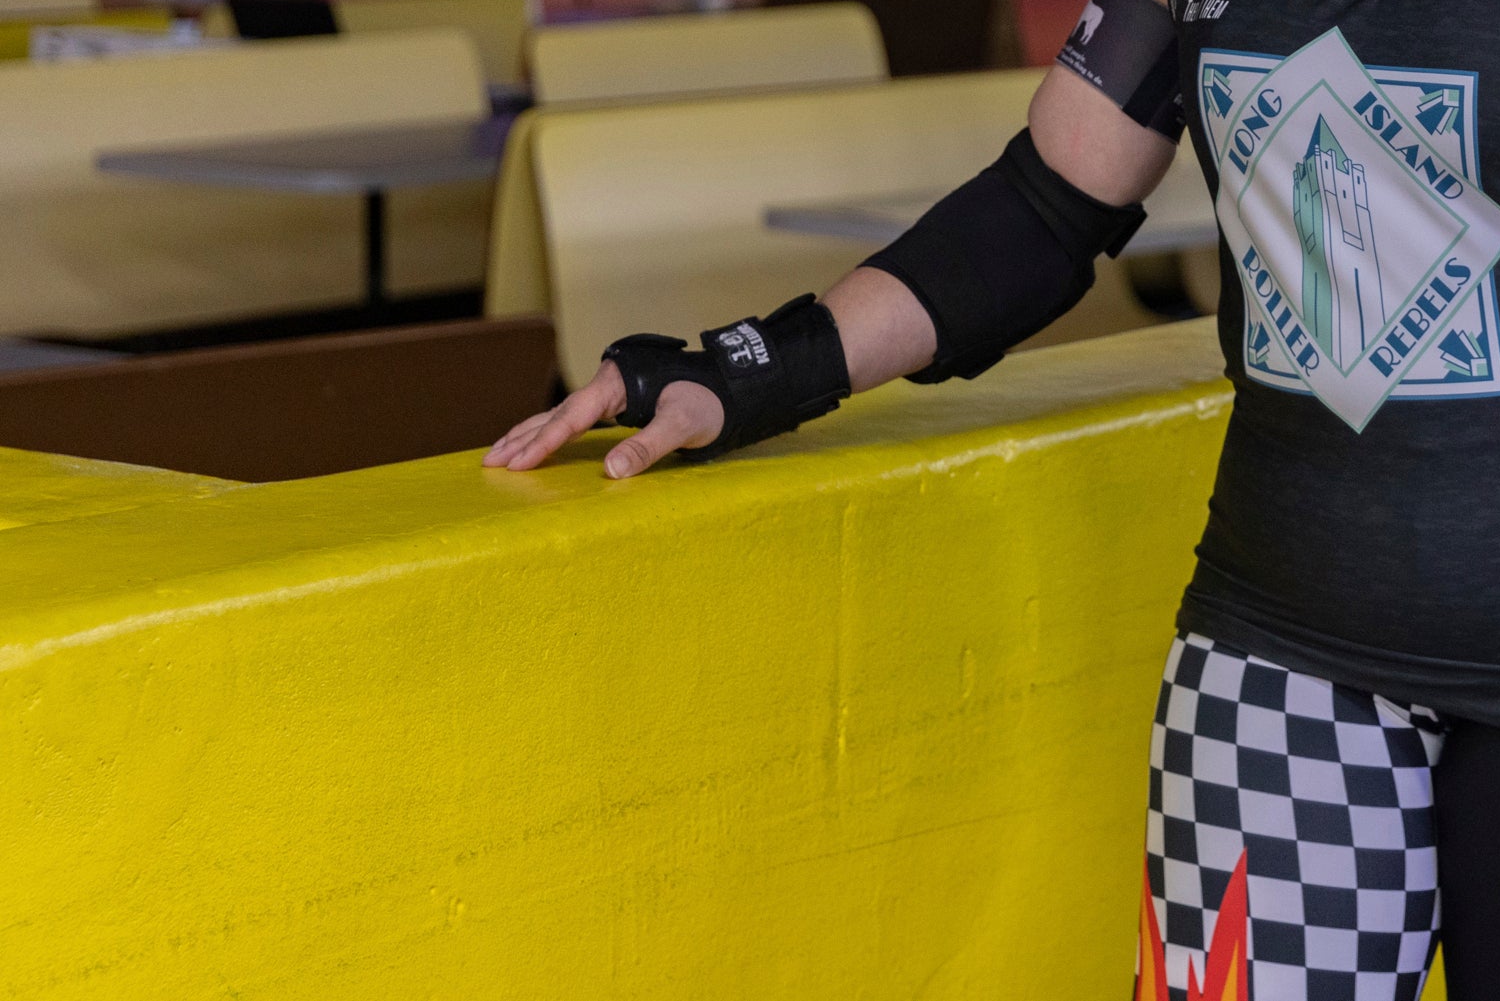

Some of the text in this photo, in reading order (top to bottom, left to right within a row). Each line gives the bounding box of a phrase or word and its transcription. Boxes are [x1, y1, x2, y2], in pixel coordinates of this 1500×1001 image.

[1228, 88, 1464, 200] LONG ISLAND
[1242, 245, 1472, 378] ROLLER REBELS
